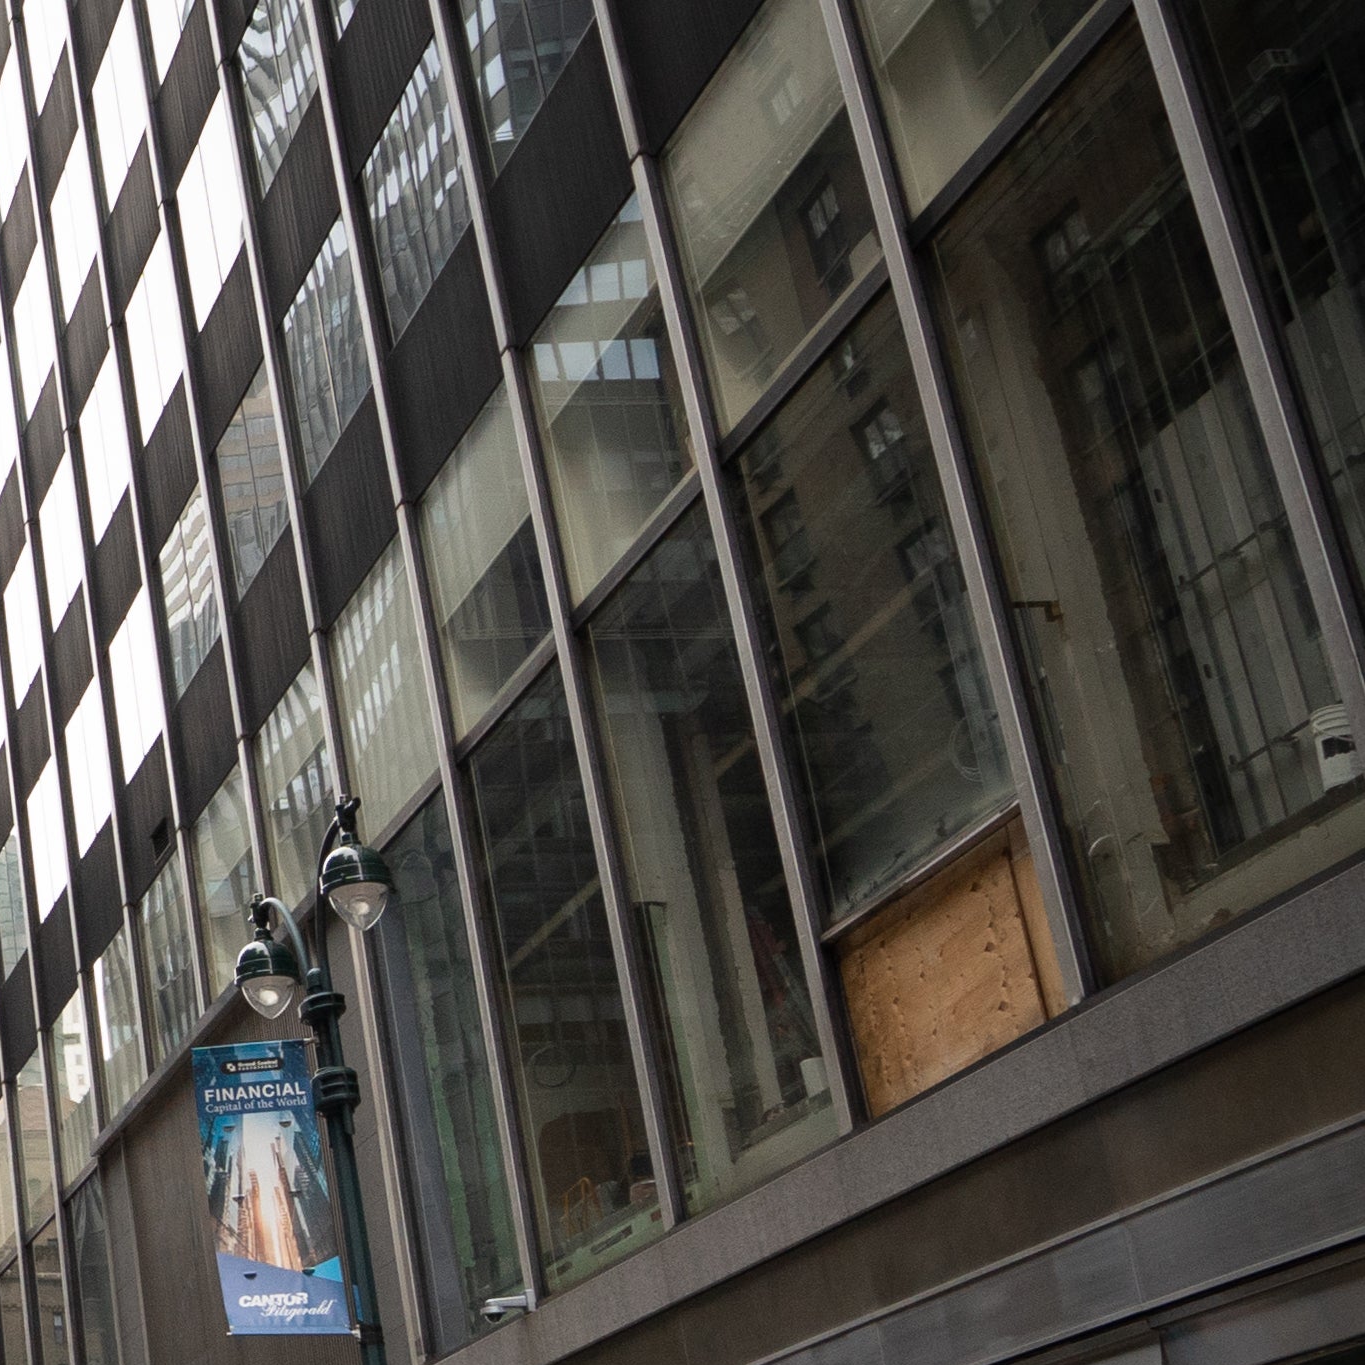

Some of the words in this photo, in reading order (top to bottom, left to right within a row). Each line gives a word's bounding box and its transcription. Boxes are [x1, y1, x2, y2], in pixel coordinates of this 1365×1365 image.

[204, 1081, 307, 1103] FINANCIAL
[205, 1102, 242, 1115] Capital
[244, 1100, 255, 1110] of
[257, 1098, 274, 1109] the
[276, 1096, 308, 1107] World
[238, 1292, 309, 1308] CANTOR
[260, 1299, 337, 1323] Fitzgerald
